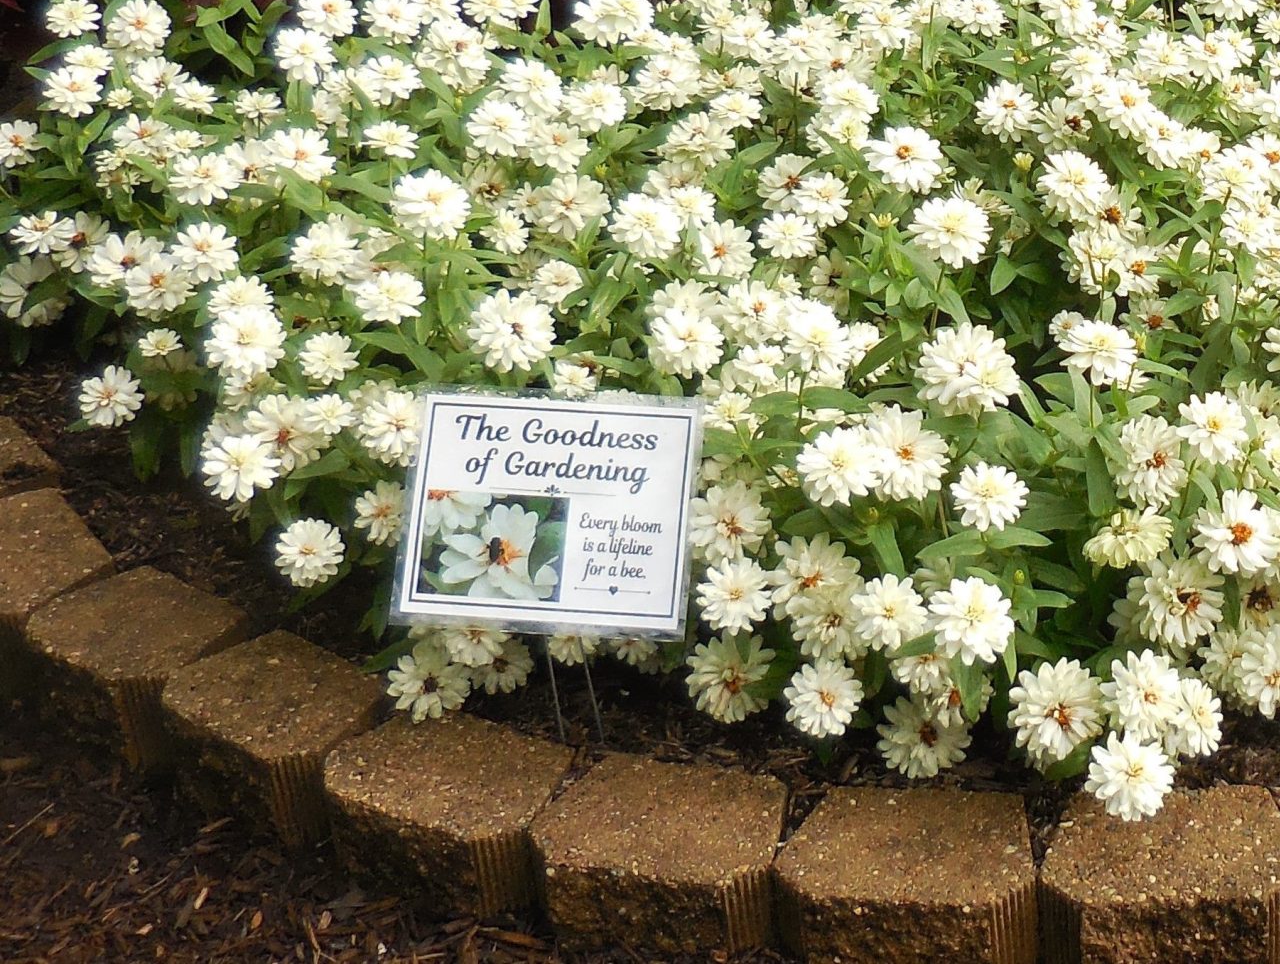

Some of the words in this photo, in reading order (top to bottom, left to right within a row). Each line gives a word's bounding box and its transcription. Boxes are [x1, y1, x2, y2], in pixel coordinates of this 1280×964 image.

[455, 413, 511, 442] The
[522, 418, 658, 450] Goodness
[465, 448, 498, 485] of
[504, 450, 651, 494] Gardening
[579, 512, 617, 537] Every
[620, 514, 662, 534] bloom
[583, 537, 594, 552] is
[597, 542, 607, 553] a
[609, 537, 653, 560] lifeline
[582, 559, 605, 582] for
[608, 566, 618, 577] a
